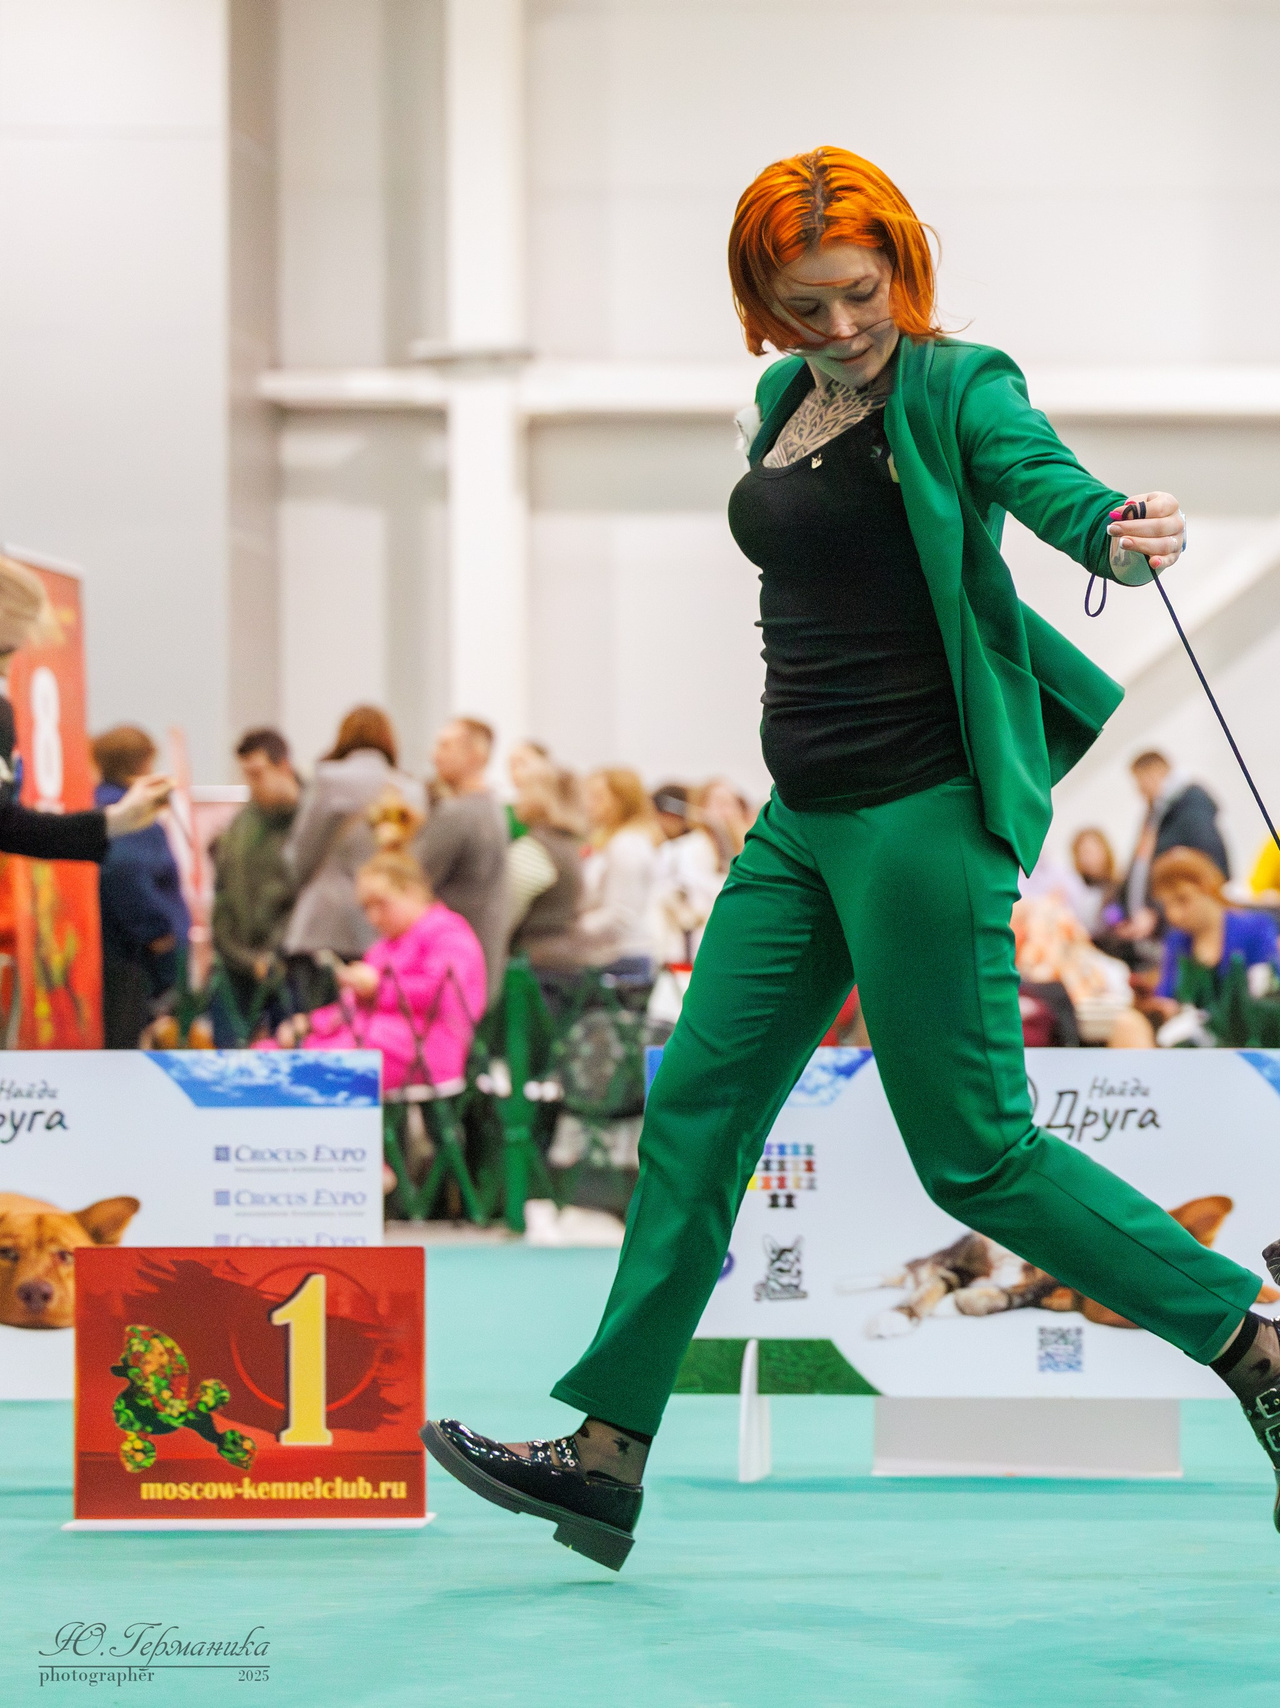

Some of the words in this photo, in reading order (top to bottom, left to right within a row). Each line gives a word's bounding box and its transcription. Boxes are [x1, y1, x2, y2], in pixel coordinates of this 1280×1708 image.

[1089, 1076, 1150, 1099] Найди
[1045, 1089, 1159, 1142] Друга
[268, 1273, 333, 1446] 1
[140, 1476, 407, 1500] moscow-kennelclub.ru
